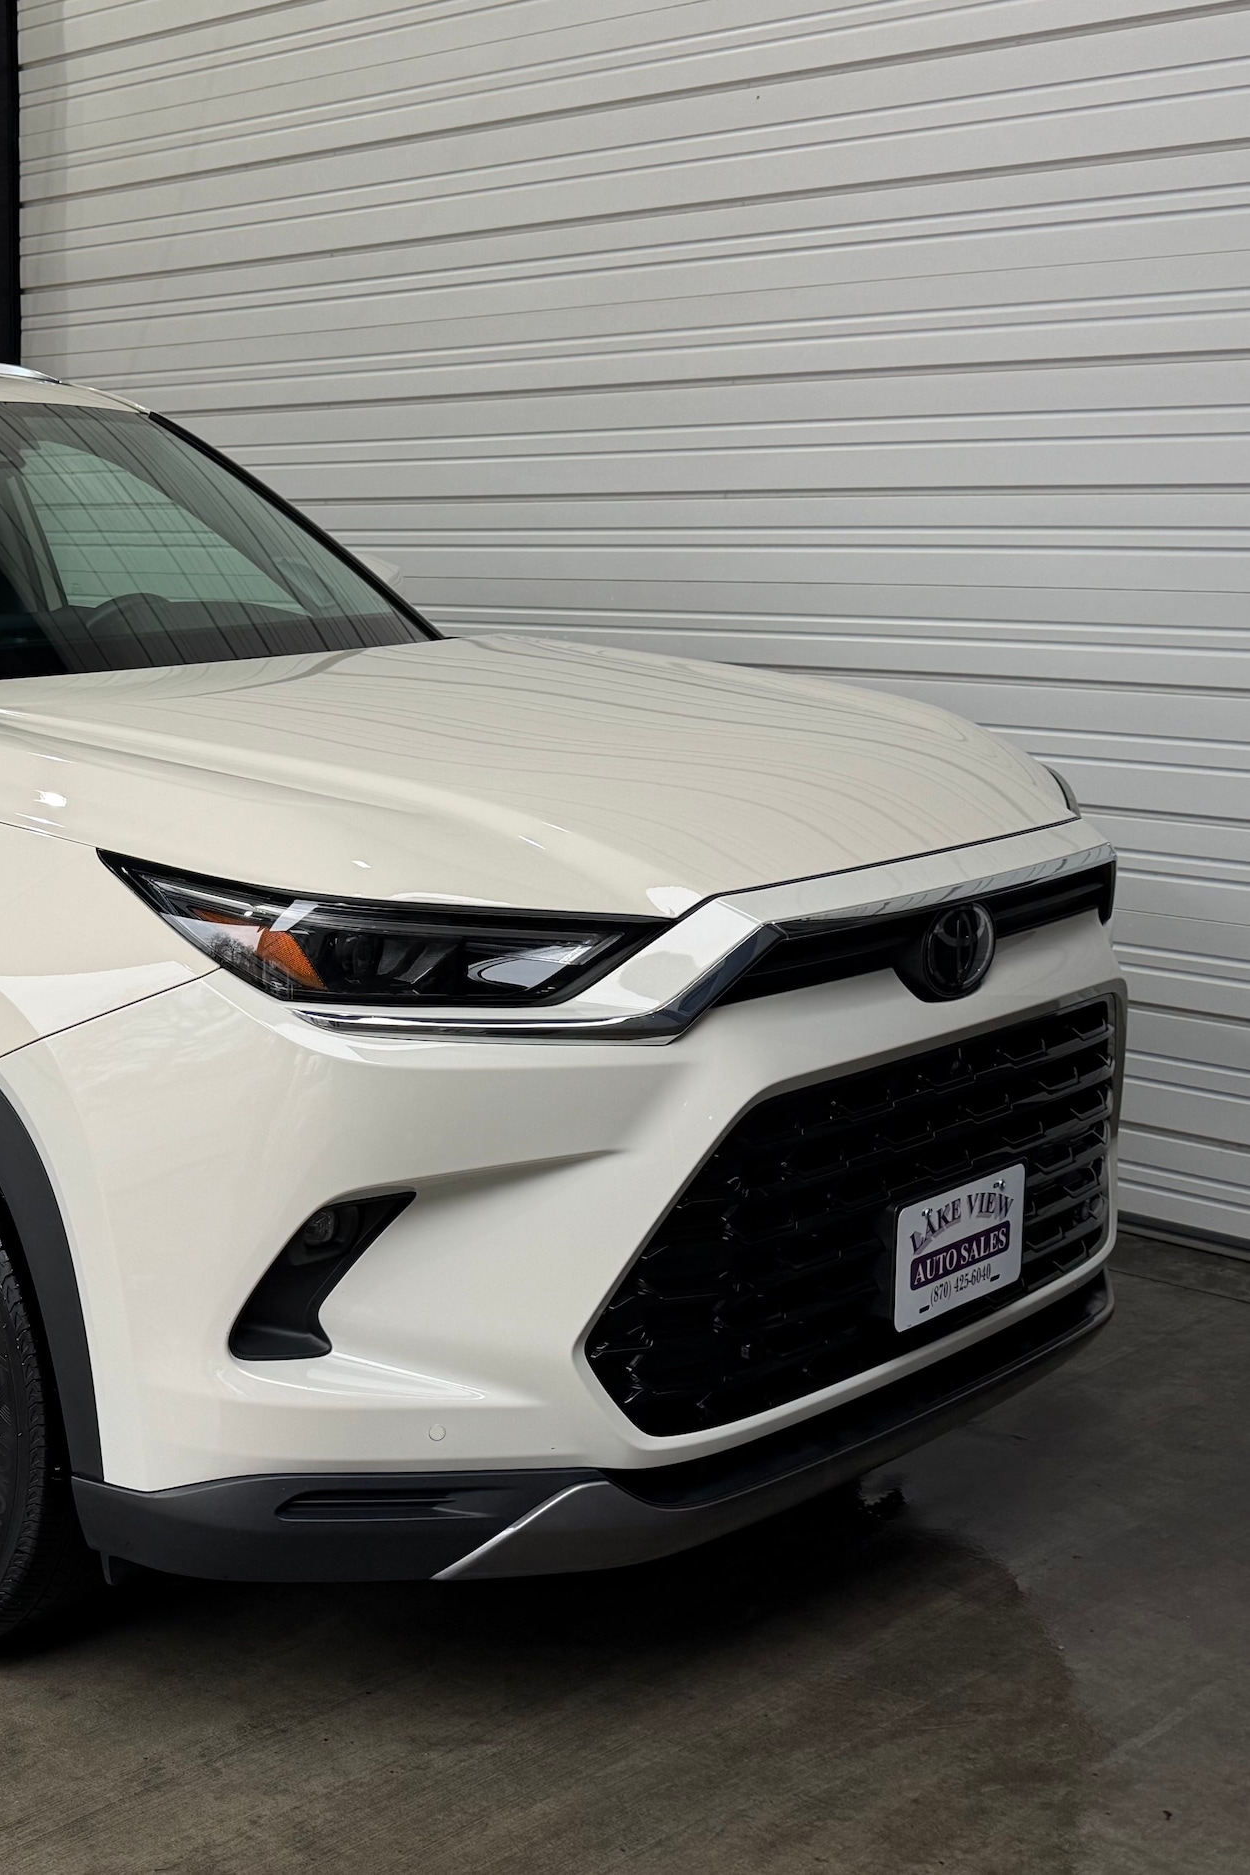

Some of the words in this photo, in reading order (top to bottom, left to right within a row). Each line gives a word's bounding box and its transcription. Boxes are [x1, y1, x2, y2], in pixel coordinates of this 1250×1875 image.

[909, 1198, 961, 1255] LAKE
[967, 1192, 1014, 1220] VIEW
[913, 1249, 958, 1286] AUTO
[960, 1228, 1007, 1265] SALES
[930, 1282, 952, 1307] (870)
[953, 1263, 991, 1293] 425-6040
